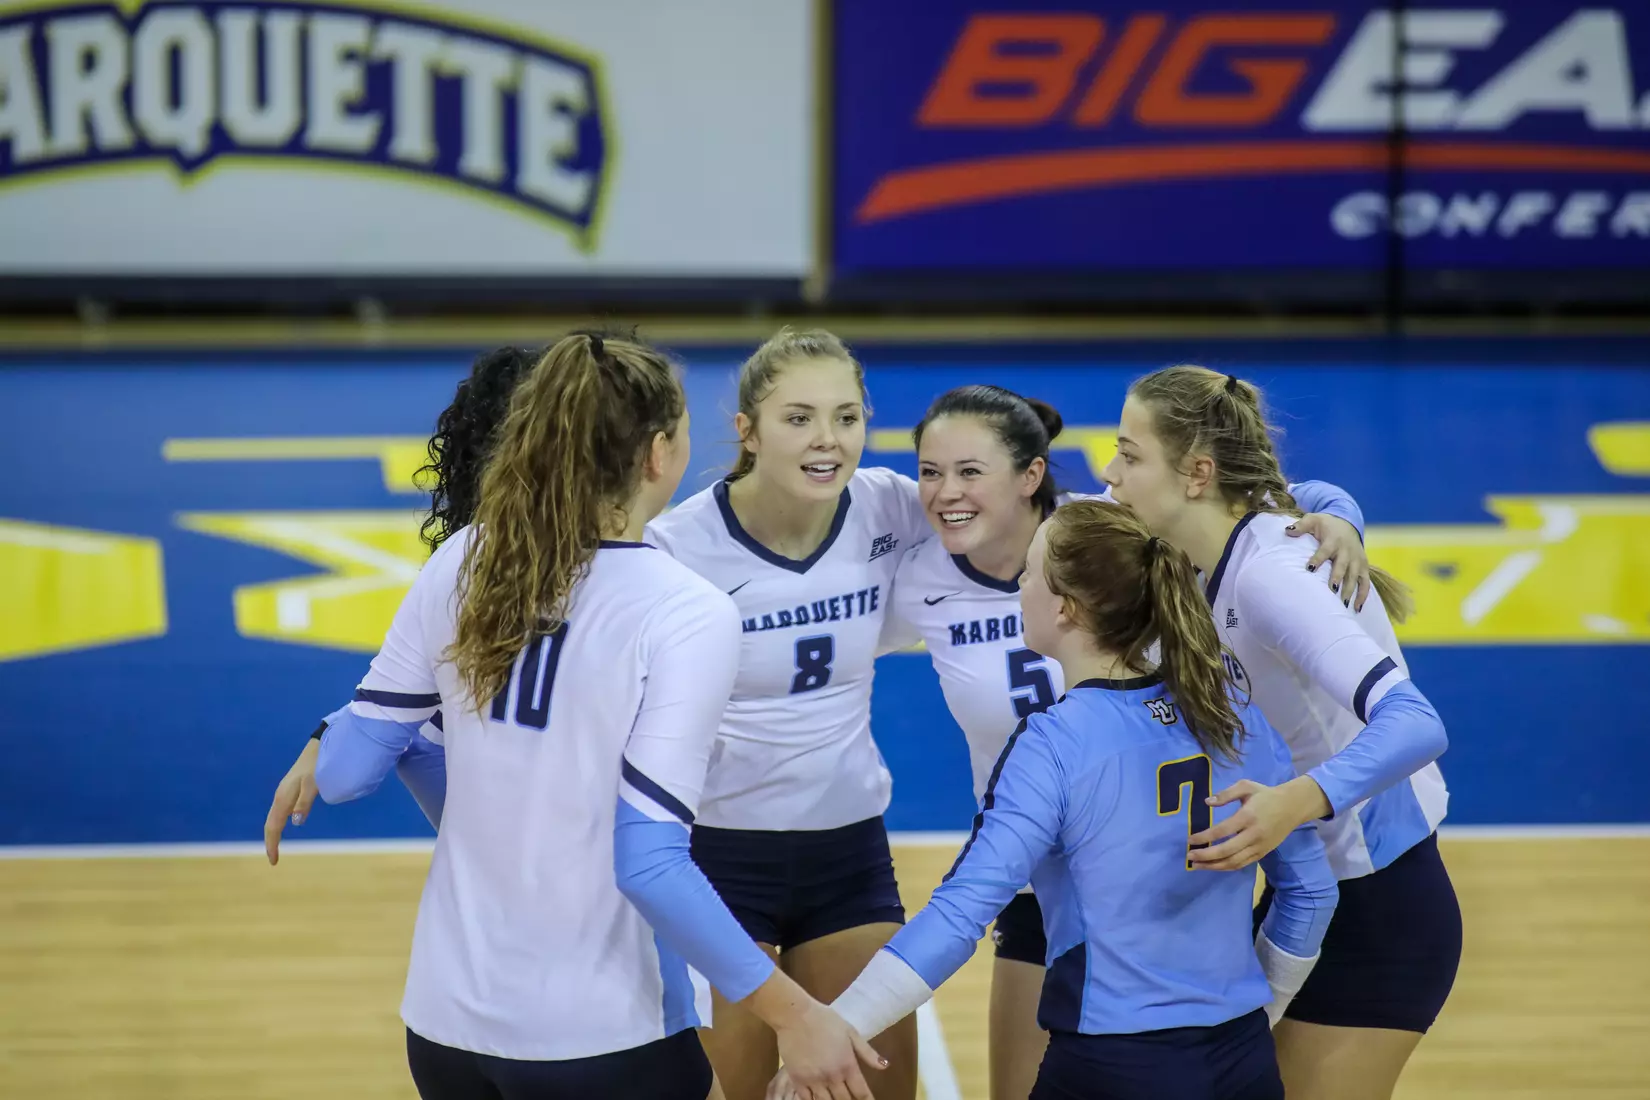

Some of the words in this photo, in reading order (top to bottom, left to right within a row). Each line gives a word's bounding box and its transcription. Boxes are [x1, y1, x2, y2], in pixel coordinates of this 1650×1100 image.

[915, 13, 1338, 128] BIG
[1300, 9, 1650, 131] EA
[870, 538, 900, 557] EAST
[872, 532, 893, 548] BIG
[741, 584, 881, 634] MARQUETTE
[948, 609, 1025, 647] MARQ
[1226, 617, 1239, 626] EAST
[789, 633, 836, 695] 8
[1005, 646, 1057, 720] 5
[1144, 697, 1178, 726] MU
[1156, 753, 1212, 872] 7
